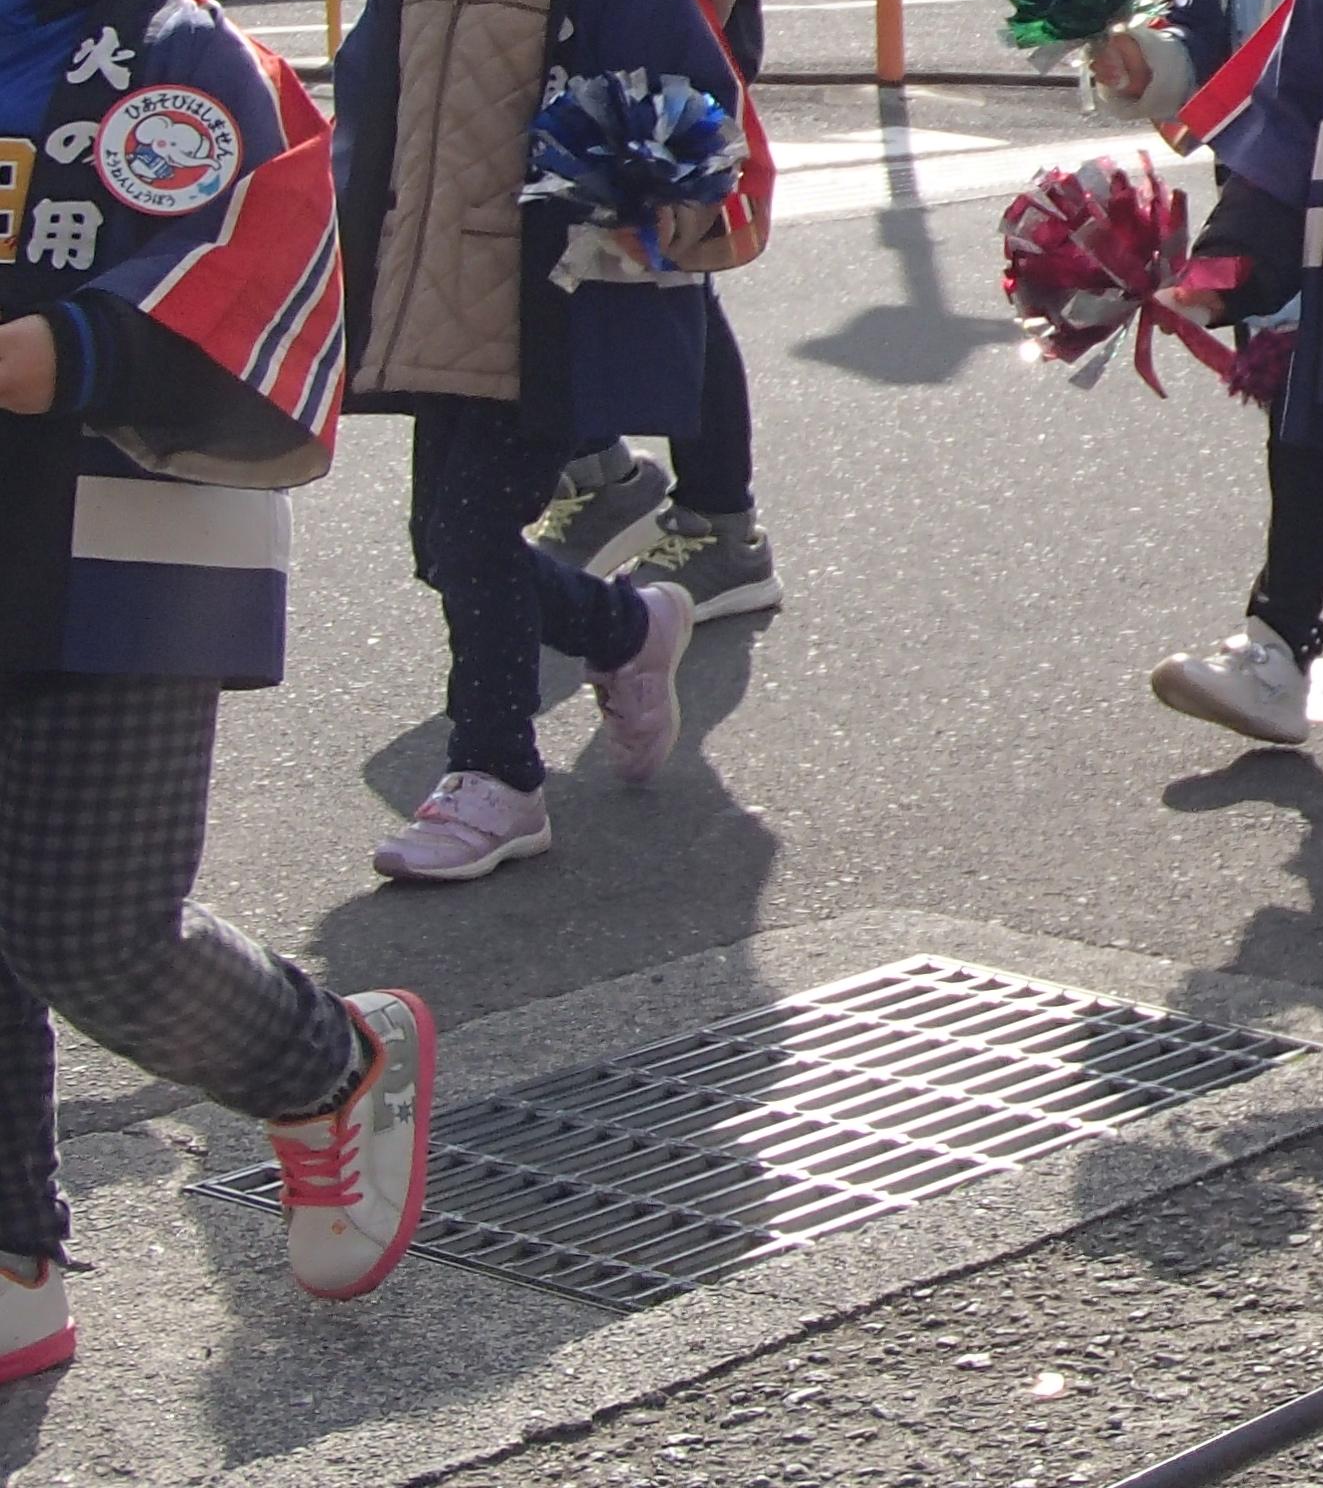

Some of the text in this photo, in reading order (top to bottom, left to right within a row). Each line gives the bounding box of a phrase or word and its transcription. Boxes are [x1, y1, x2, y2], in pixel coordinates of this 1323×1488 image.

[124, 93, 234, 162] ひあそびはしません
[105, 149, 176, 207] ようねんしょうぼう
